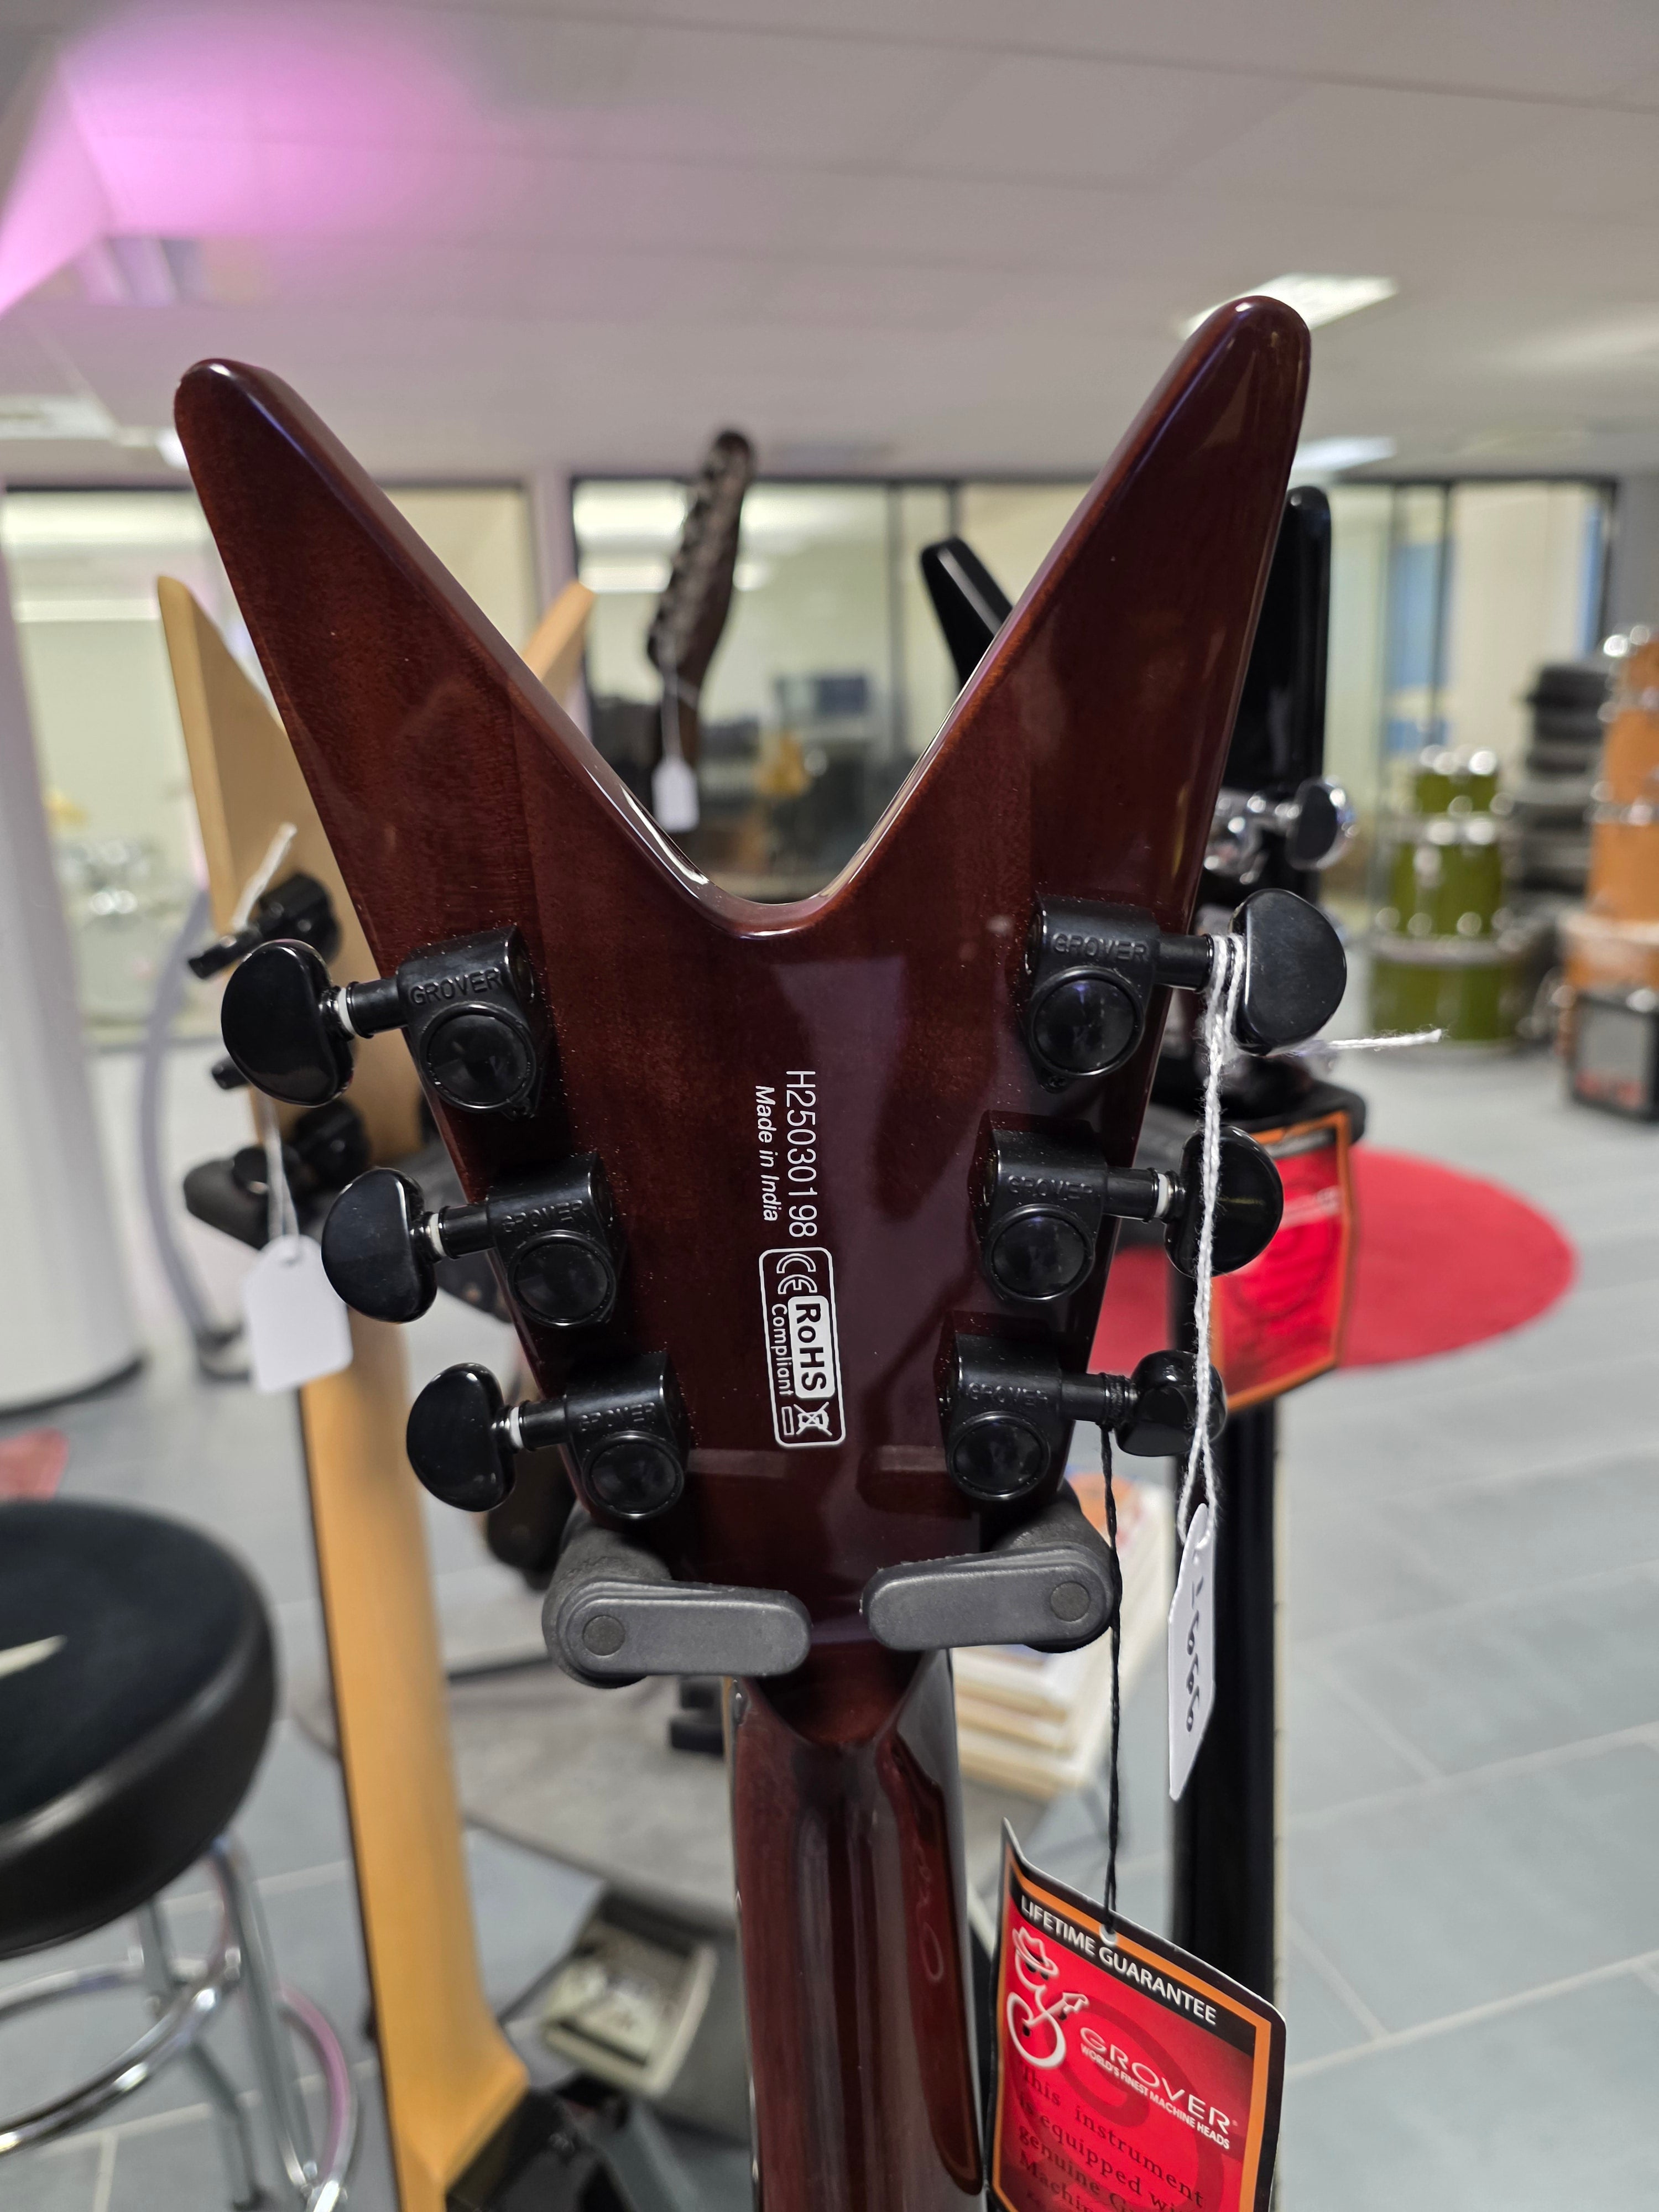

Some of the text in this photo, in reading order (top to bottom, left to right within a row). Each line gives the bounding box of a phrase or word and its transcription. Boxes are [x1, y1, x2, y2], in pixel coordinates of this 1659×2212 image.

[410, 968, 504, 1004] GROVER
[1052, 932, 1149, 963] GROVER
[755, 1085, 782, 1221] Made in India
[786, 1071, 818, 1237] H25030198
[770, 1303, 794, 1396] Compliant
[795, 1302, 827, 1391] RoHS
[1021, 1894, 1217, 2026] LIFETIME GUARANTEE
[1080, 2027, 1230, 2135] GROVER
[1080, 2042, 1230, 2150] WORLD'S FINEST MACHINE HEADS
[1019, 2125, 1100, 2195] genuine
[1022, 2062, 1204, 2209] This instrument
[1040, 2115, 1142, 2196] equipped
